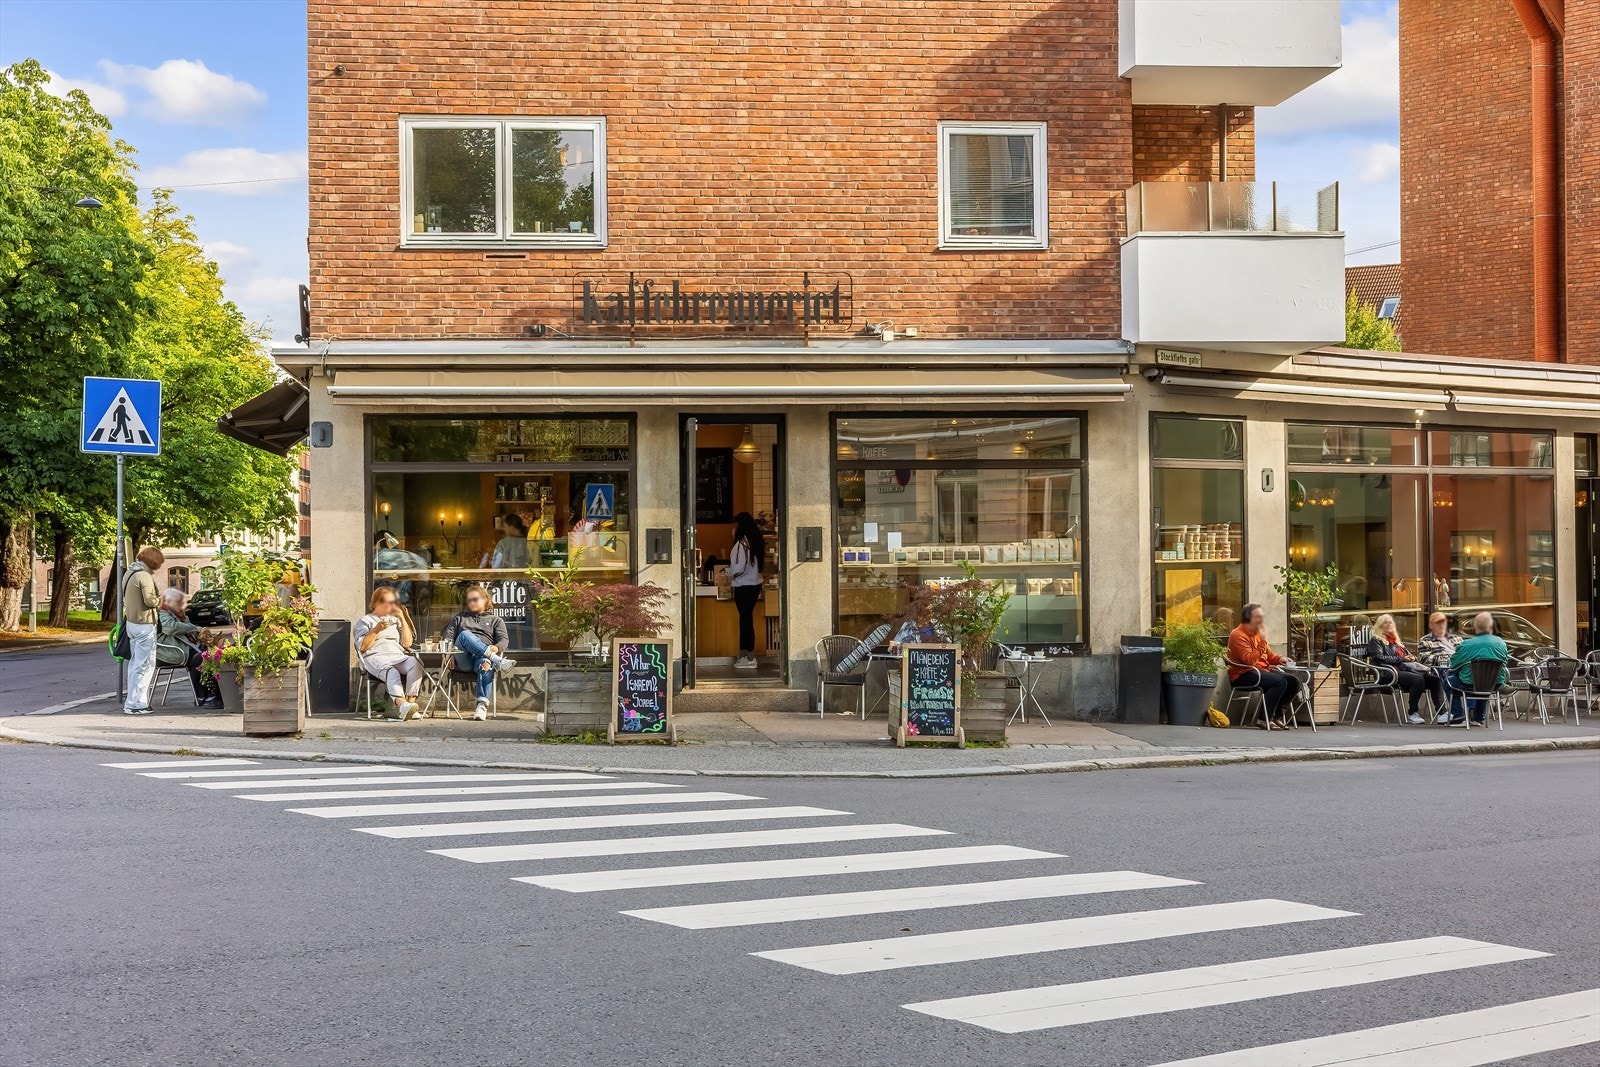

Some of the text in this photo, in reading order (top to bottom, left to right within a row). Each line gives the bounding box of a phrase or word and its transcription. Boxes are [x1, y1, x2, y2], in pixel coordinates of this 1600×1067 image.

[582, 278, 845, 325] Kaffebrenneriet
[490, 606, 526, 617] nneriet
[920, 666, 938, 680] KAFFE
